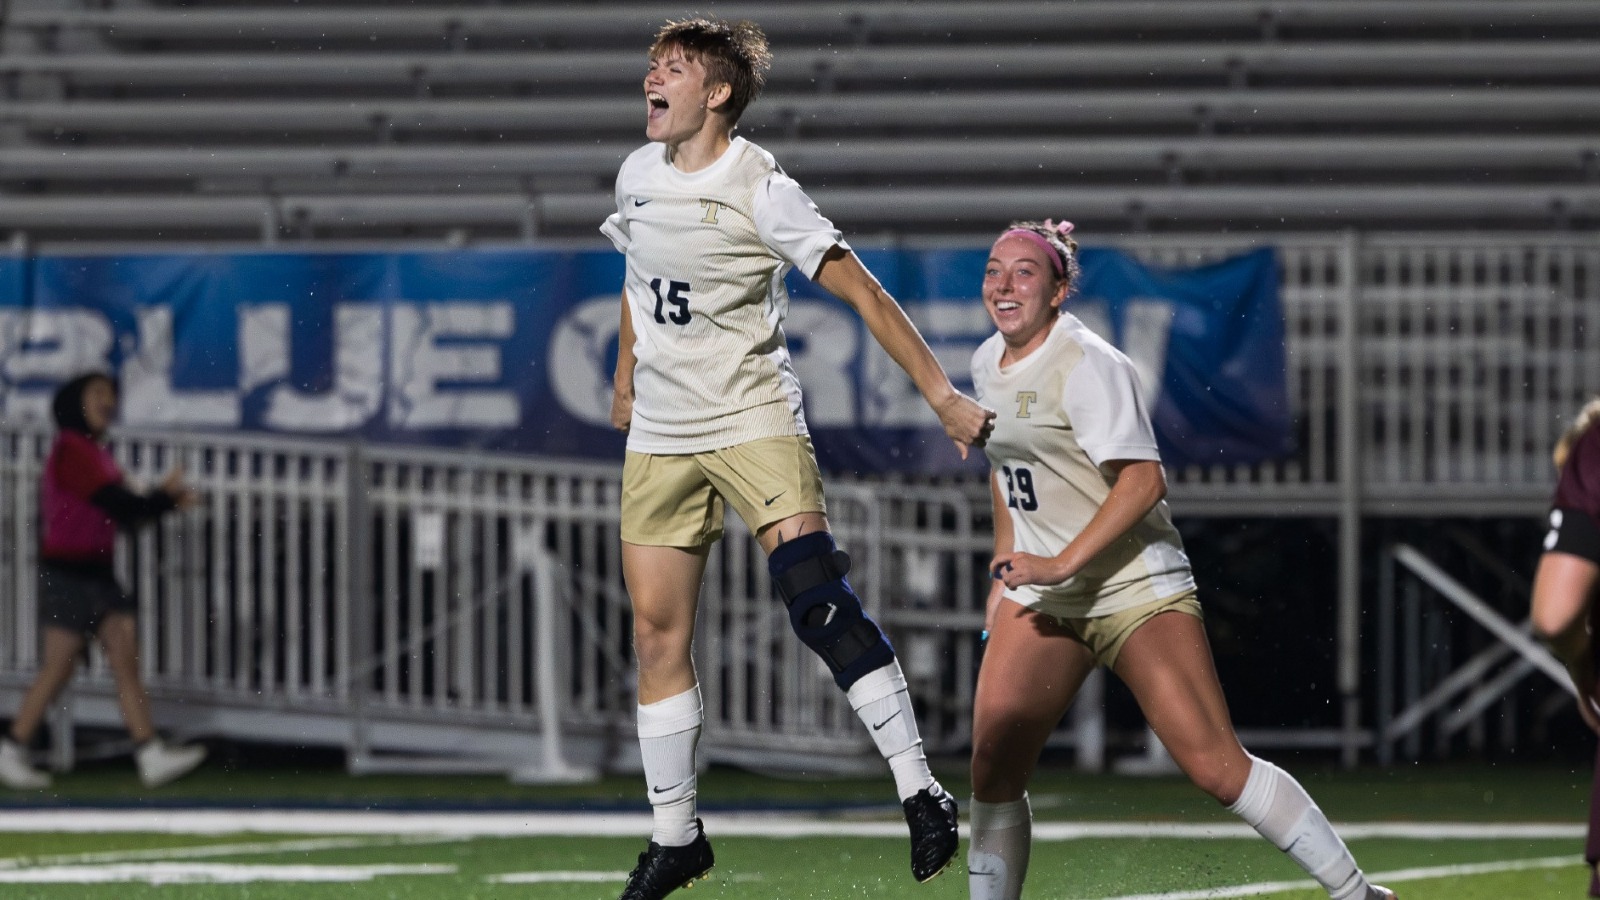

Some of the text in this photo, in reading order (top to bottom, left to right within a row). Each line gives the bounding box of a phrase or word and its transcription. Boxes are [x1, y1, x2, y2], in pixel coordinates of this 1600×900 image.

[700, 198, 727, 225] T
[650, 278, 692, 325] 15
[0, 302, 522, 430] BLUE
[1015, 391, 1037, 418] T
[1002, 465, 1039, 511] 29
